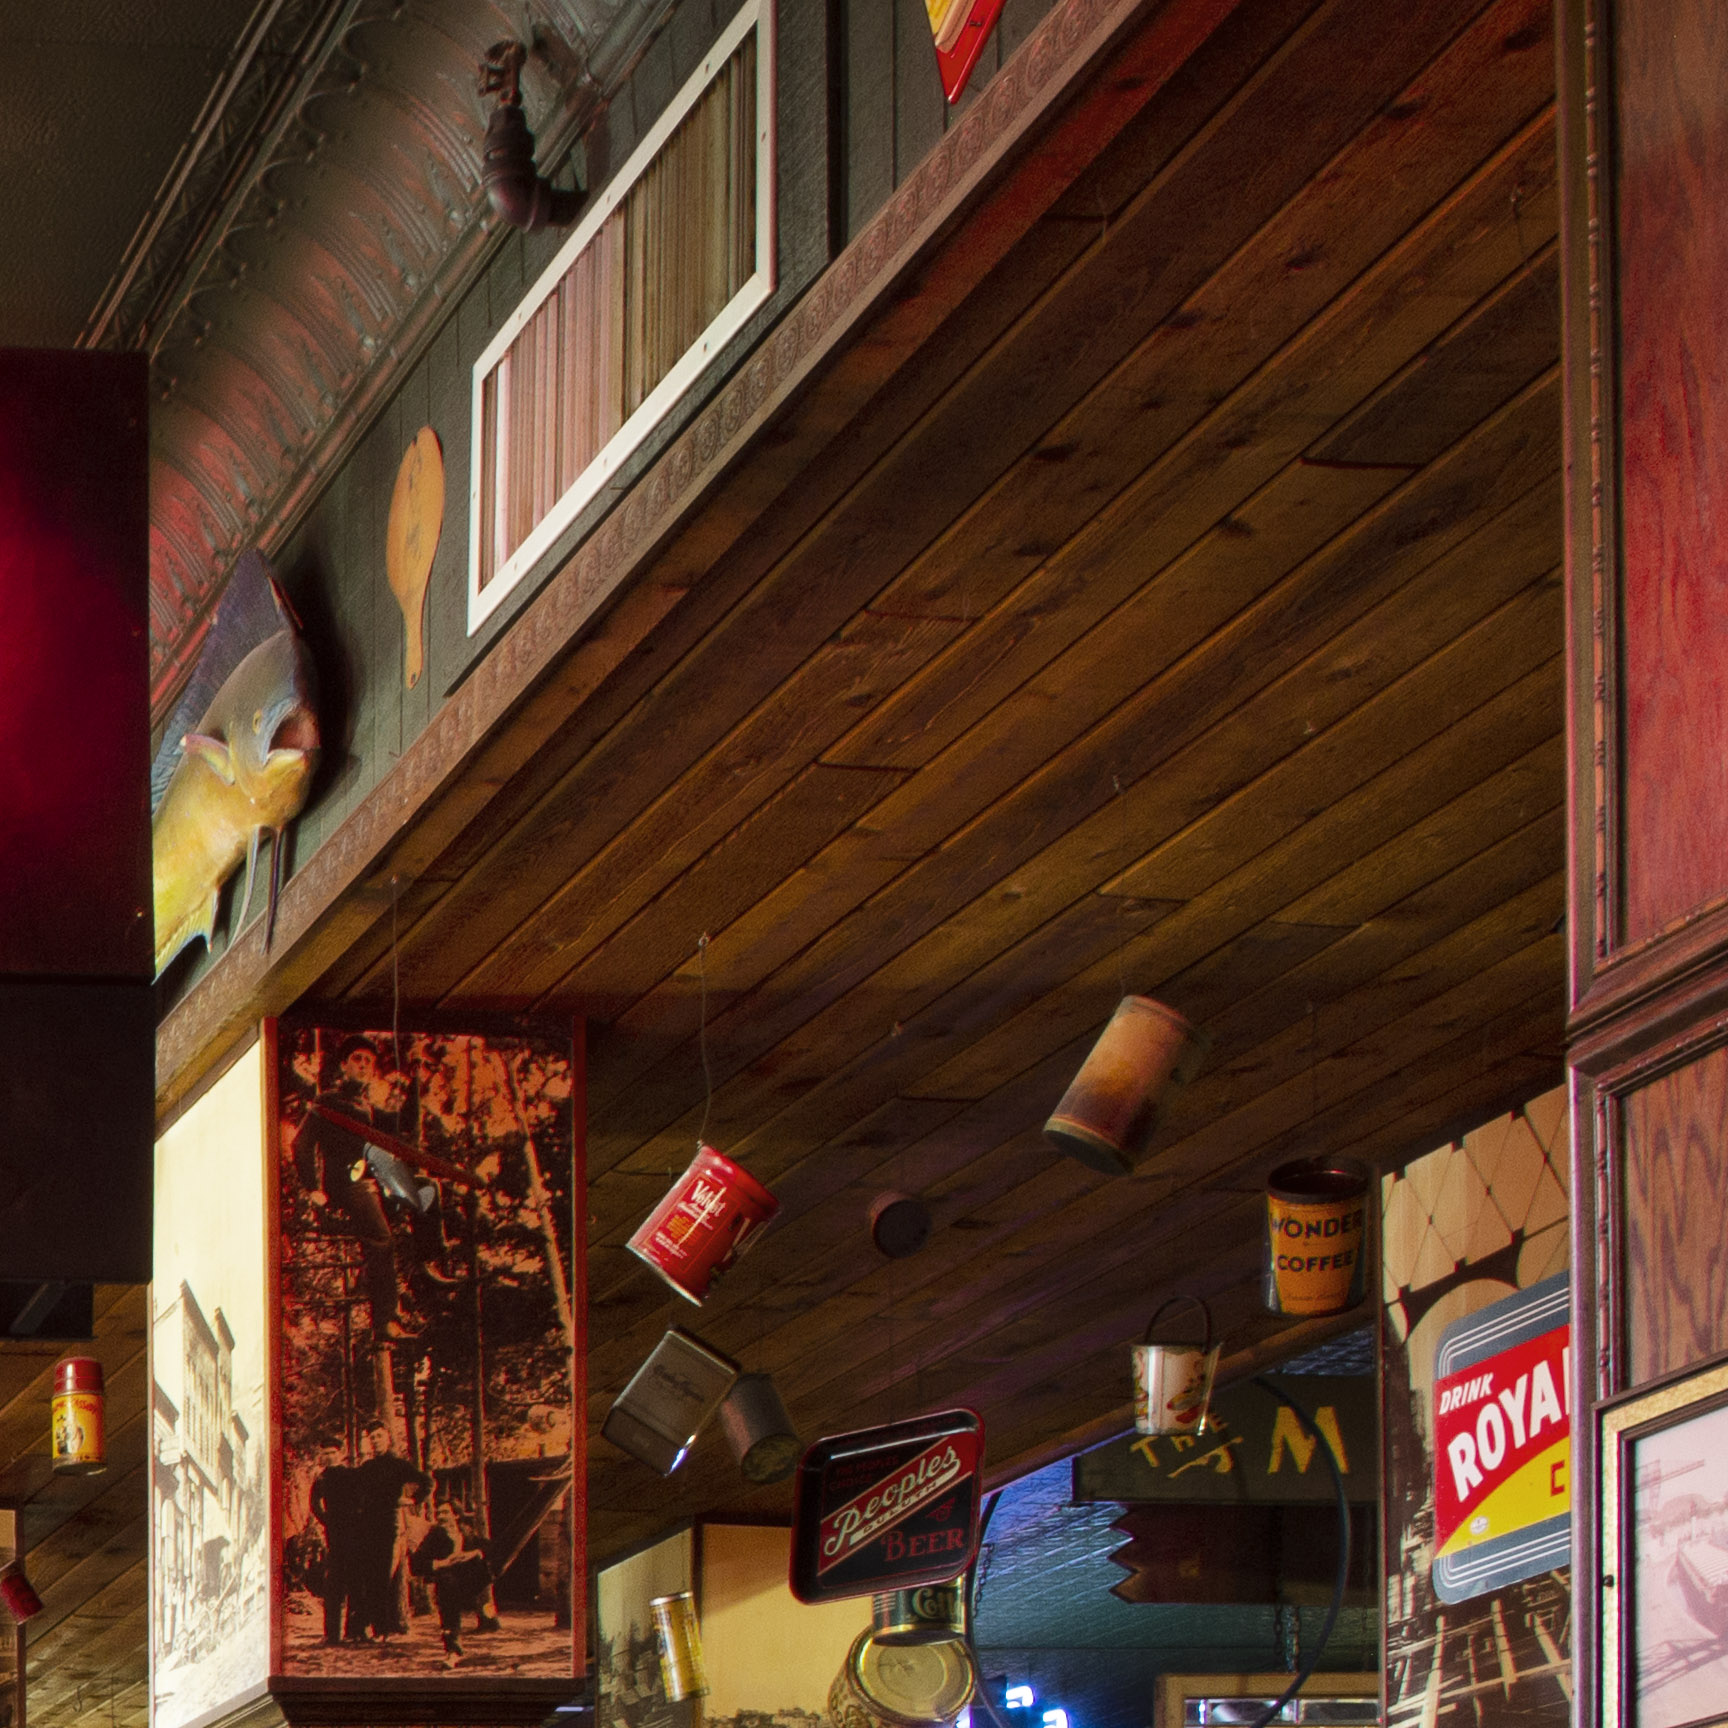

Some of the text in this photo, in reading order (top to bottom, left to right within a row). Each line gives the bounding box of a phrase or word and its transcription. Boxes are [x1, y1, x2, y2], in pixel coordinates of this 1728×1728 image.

[1278, 1254, 1353, 1272] COFFEE
[1439, 1372, 1493, 1415] DRINK
[824, 1445, 961, 1556] Peoples
[881, 1527, 963, 1562] BEER
